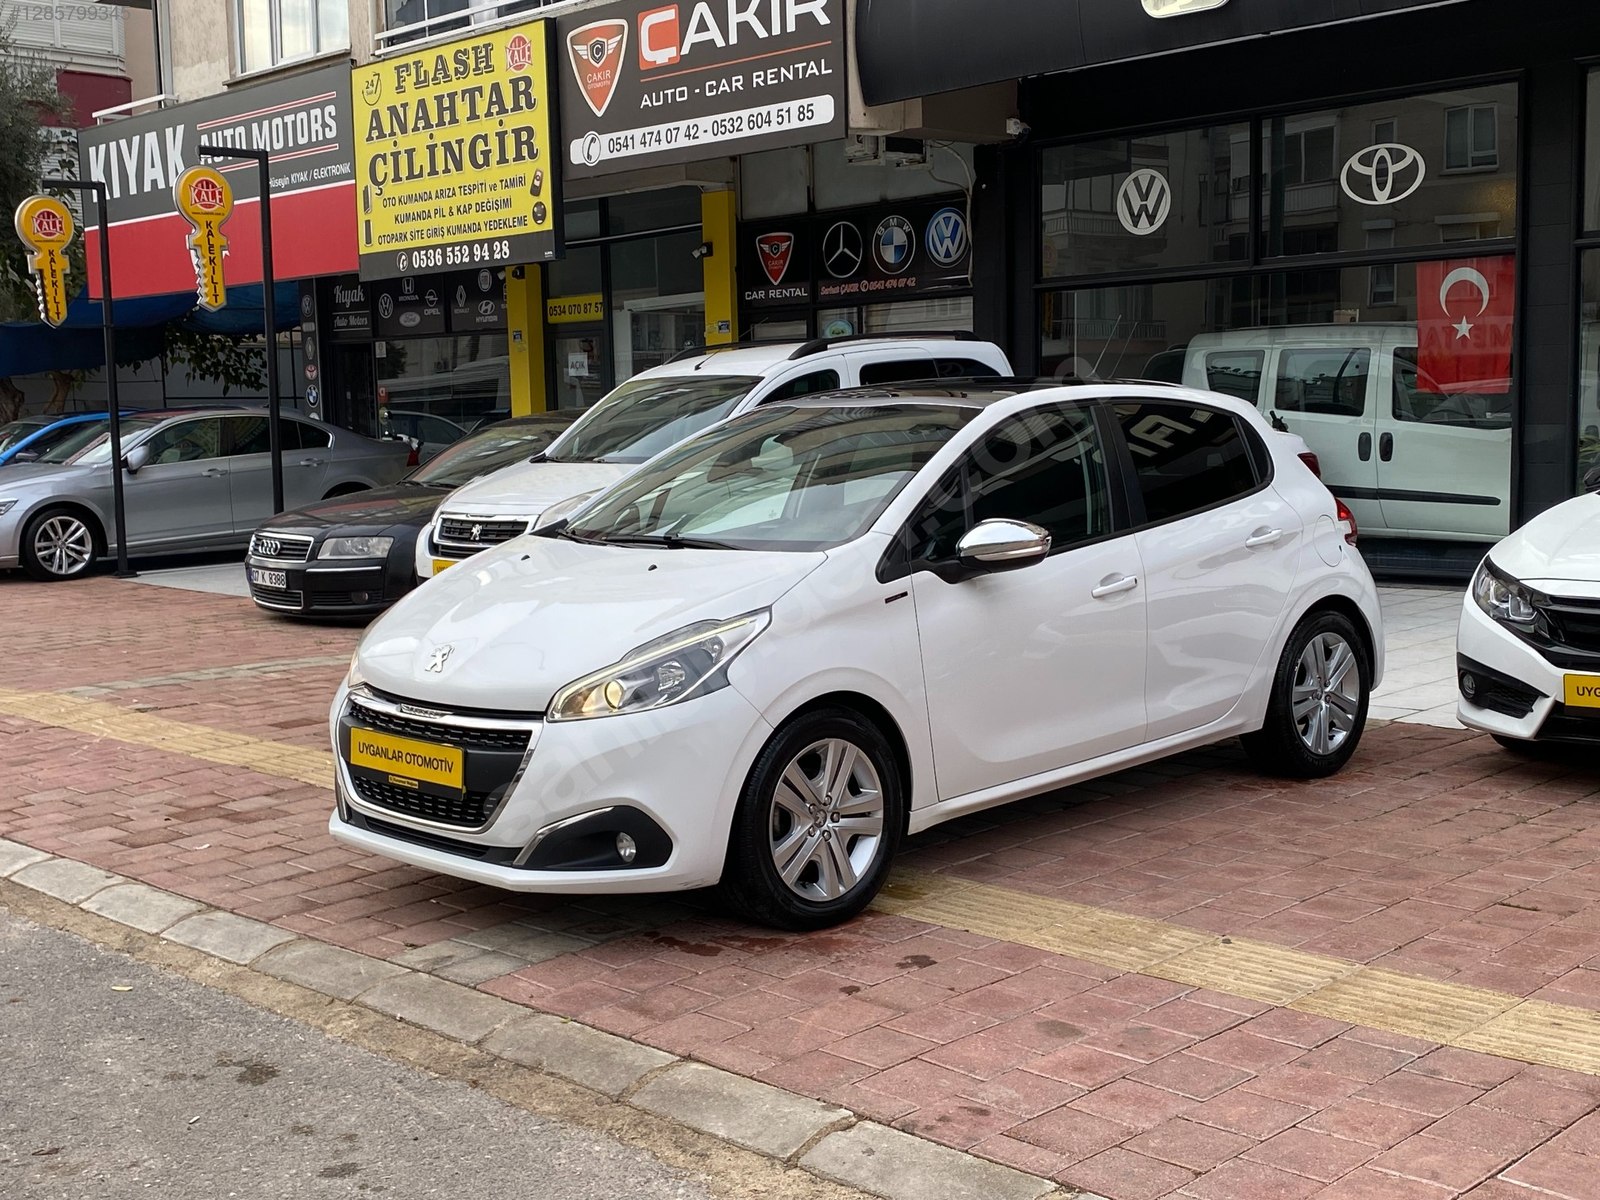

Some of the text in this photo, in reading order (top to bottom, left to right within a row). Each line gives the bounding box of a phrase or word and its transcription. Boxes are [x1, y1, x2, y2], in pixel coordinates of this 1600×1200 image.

[394, 43, 494, 93] FLASH
[506, 46, 532, 66] KALE
[640, 86, 688, 109] AUTO
[705, 75, 744, 97] CAR
[752, 59, 833, 88] RENTAL
[366, 75, 537, 142] ANAHTAR
[608, 134, 636, 154] 0541
[640, 130, 662, 148] 474
[665, 127, 680, 145] 07
[684, 124, 700, 141] 42
[711, 116, 744, 137] 0532
[747, 110, 772, 131] 604
[776, 106, 792, 126] 51
[797, 103, 815, 122] 85
[88, 105, 337, 202] KIYAK AUTO MOTORS
[369, 119, 539, 196] ÇİLİNGİR
[290, 170, 308, 184] KIYAK
[383, 174, 526, 208] OTO KUMANDA ARIZA TESPİTİ ve TAMİRİ
[191, 187, 224, 207] KALE
[33, 217, 63, 234] KALE
[395, 209, 432, 224] KUMANDA
[434, 206, 446, 219] PİL
[448, 207, 454, 217] &
[456, 203, 473, 215] KAP
[378, 215, 528, 245] OTOPARK SİTE GİRİŞ KUMANDA YEDEKLEME
[412, 240, 510, 268] 0536 552 94 28
[745, 288, 808, 300] CAR RENTAL
[549, 302, 603, 317] 0534 070 87 57
[570, 361, 586, 371] AÇIK
[261, 571, 267, 583] K
[269, 572, 286, 587] 8388
[358, 741, 454, 774] UYGANLAR OTOMOTİV
